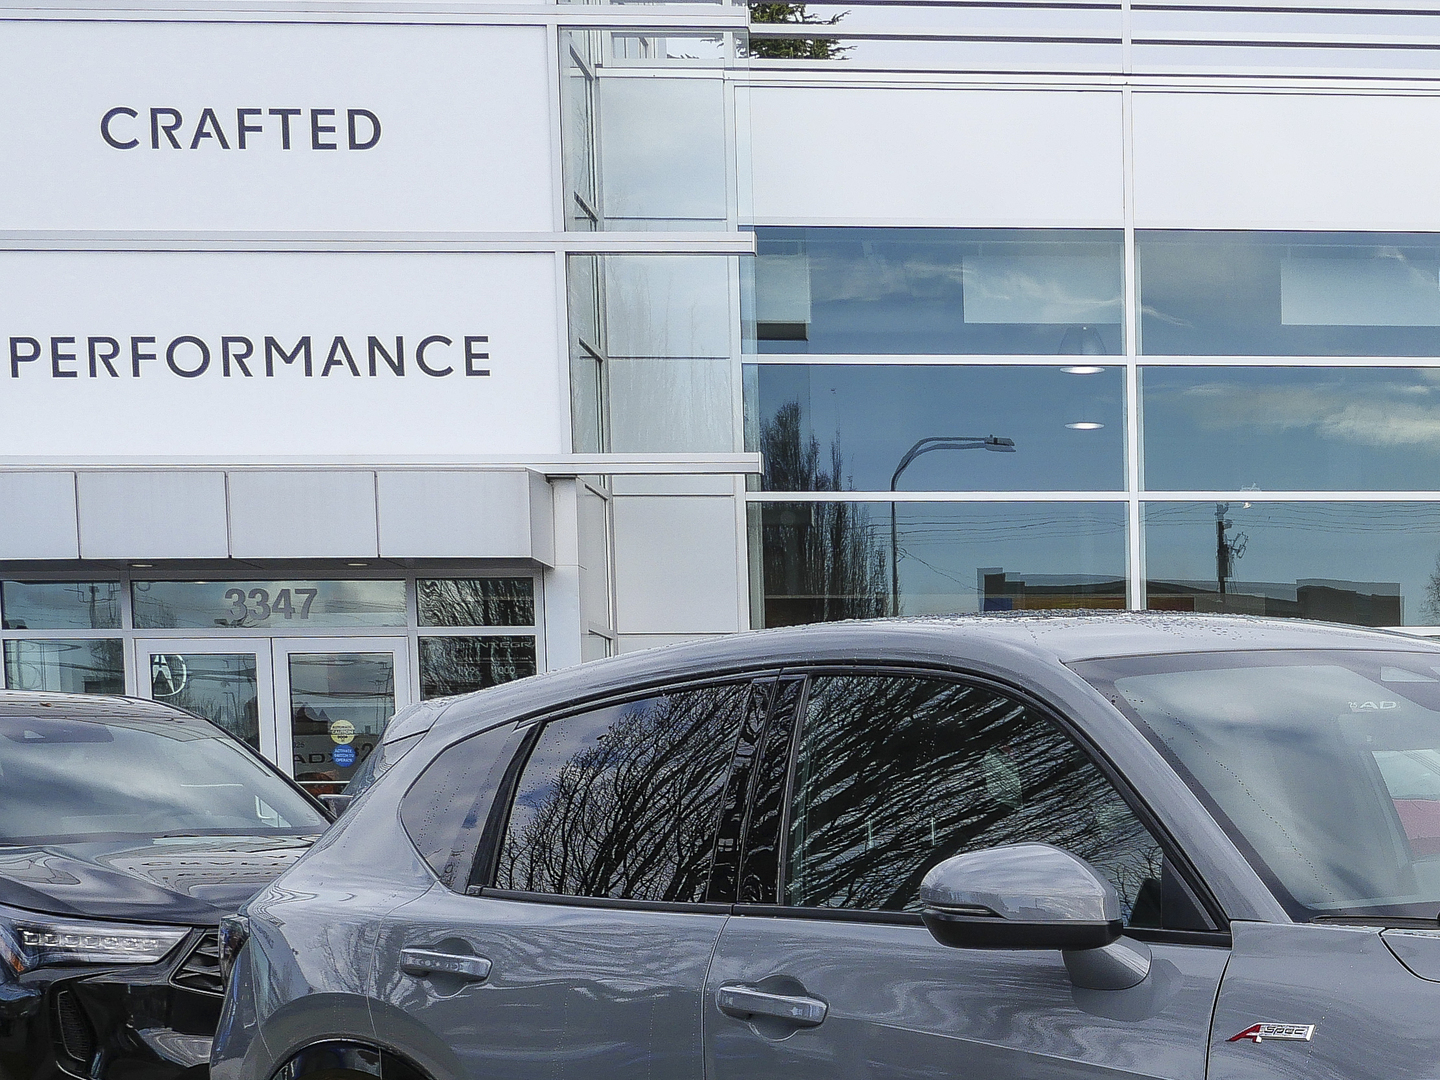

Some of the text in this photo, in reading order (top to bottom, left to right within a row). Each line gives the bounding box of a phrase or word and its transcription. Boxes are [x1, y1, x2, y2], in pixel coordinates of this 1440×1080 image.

[100, 106, 382, 150] CRAFTED
[9, 336, 491, 378] PERFORMANCE
[224, 588, 318, 620] 3347
